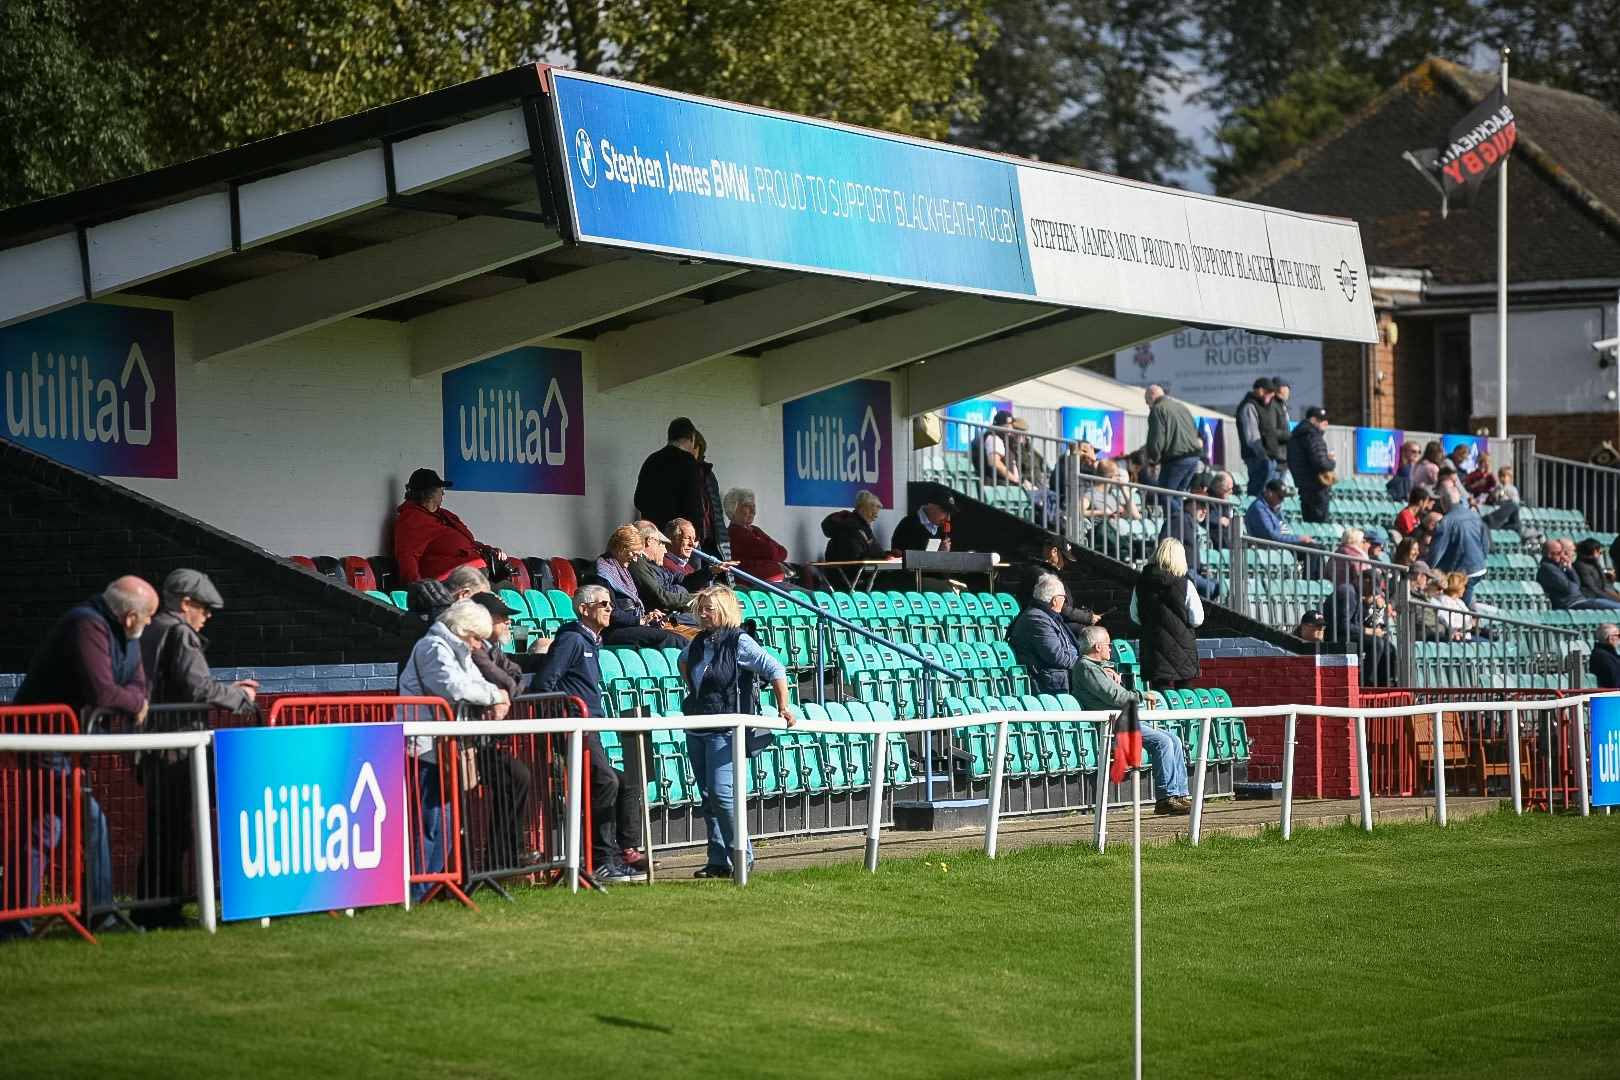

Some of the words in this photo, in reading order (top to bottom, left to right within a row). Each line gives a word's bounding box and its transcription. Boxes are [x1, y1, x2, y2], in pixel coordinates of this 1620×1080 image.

[600, 138, 666, 193] Stephen
[665, 151, 712, 197] James
[710, 158, 755, 203] BMW.
[755, 166, 807, 211] PROUD
[806, 174, 828, 214] TO
[829, 178, 892, 224] SUPPORT
[894, 190, 978, 238] BLACKHEATH
[1030, 217, 1080, 253] STEPHEN
[1080, 225, 1115, 259] JAMES
[1141, 236, 1175, 269] PROUD
[1174, 242, 1190, 272] TO
[1192, 244, 1236, 278] SUPPORT
[1234, 252, 1296, 287] BLACKHEATH
[1293, 261, 1326, 291] RUGBY.
[1205, 346, 1271, 366] RUGBY
[5, 351, 120, 444] utilita
[459, 387, 543, 465] utilita
[796, 414, 861, 482] utilita
[1598, 730, 1620, 783] uti
[239, 783, 350, 879] utilita
